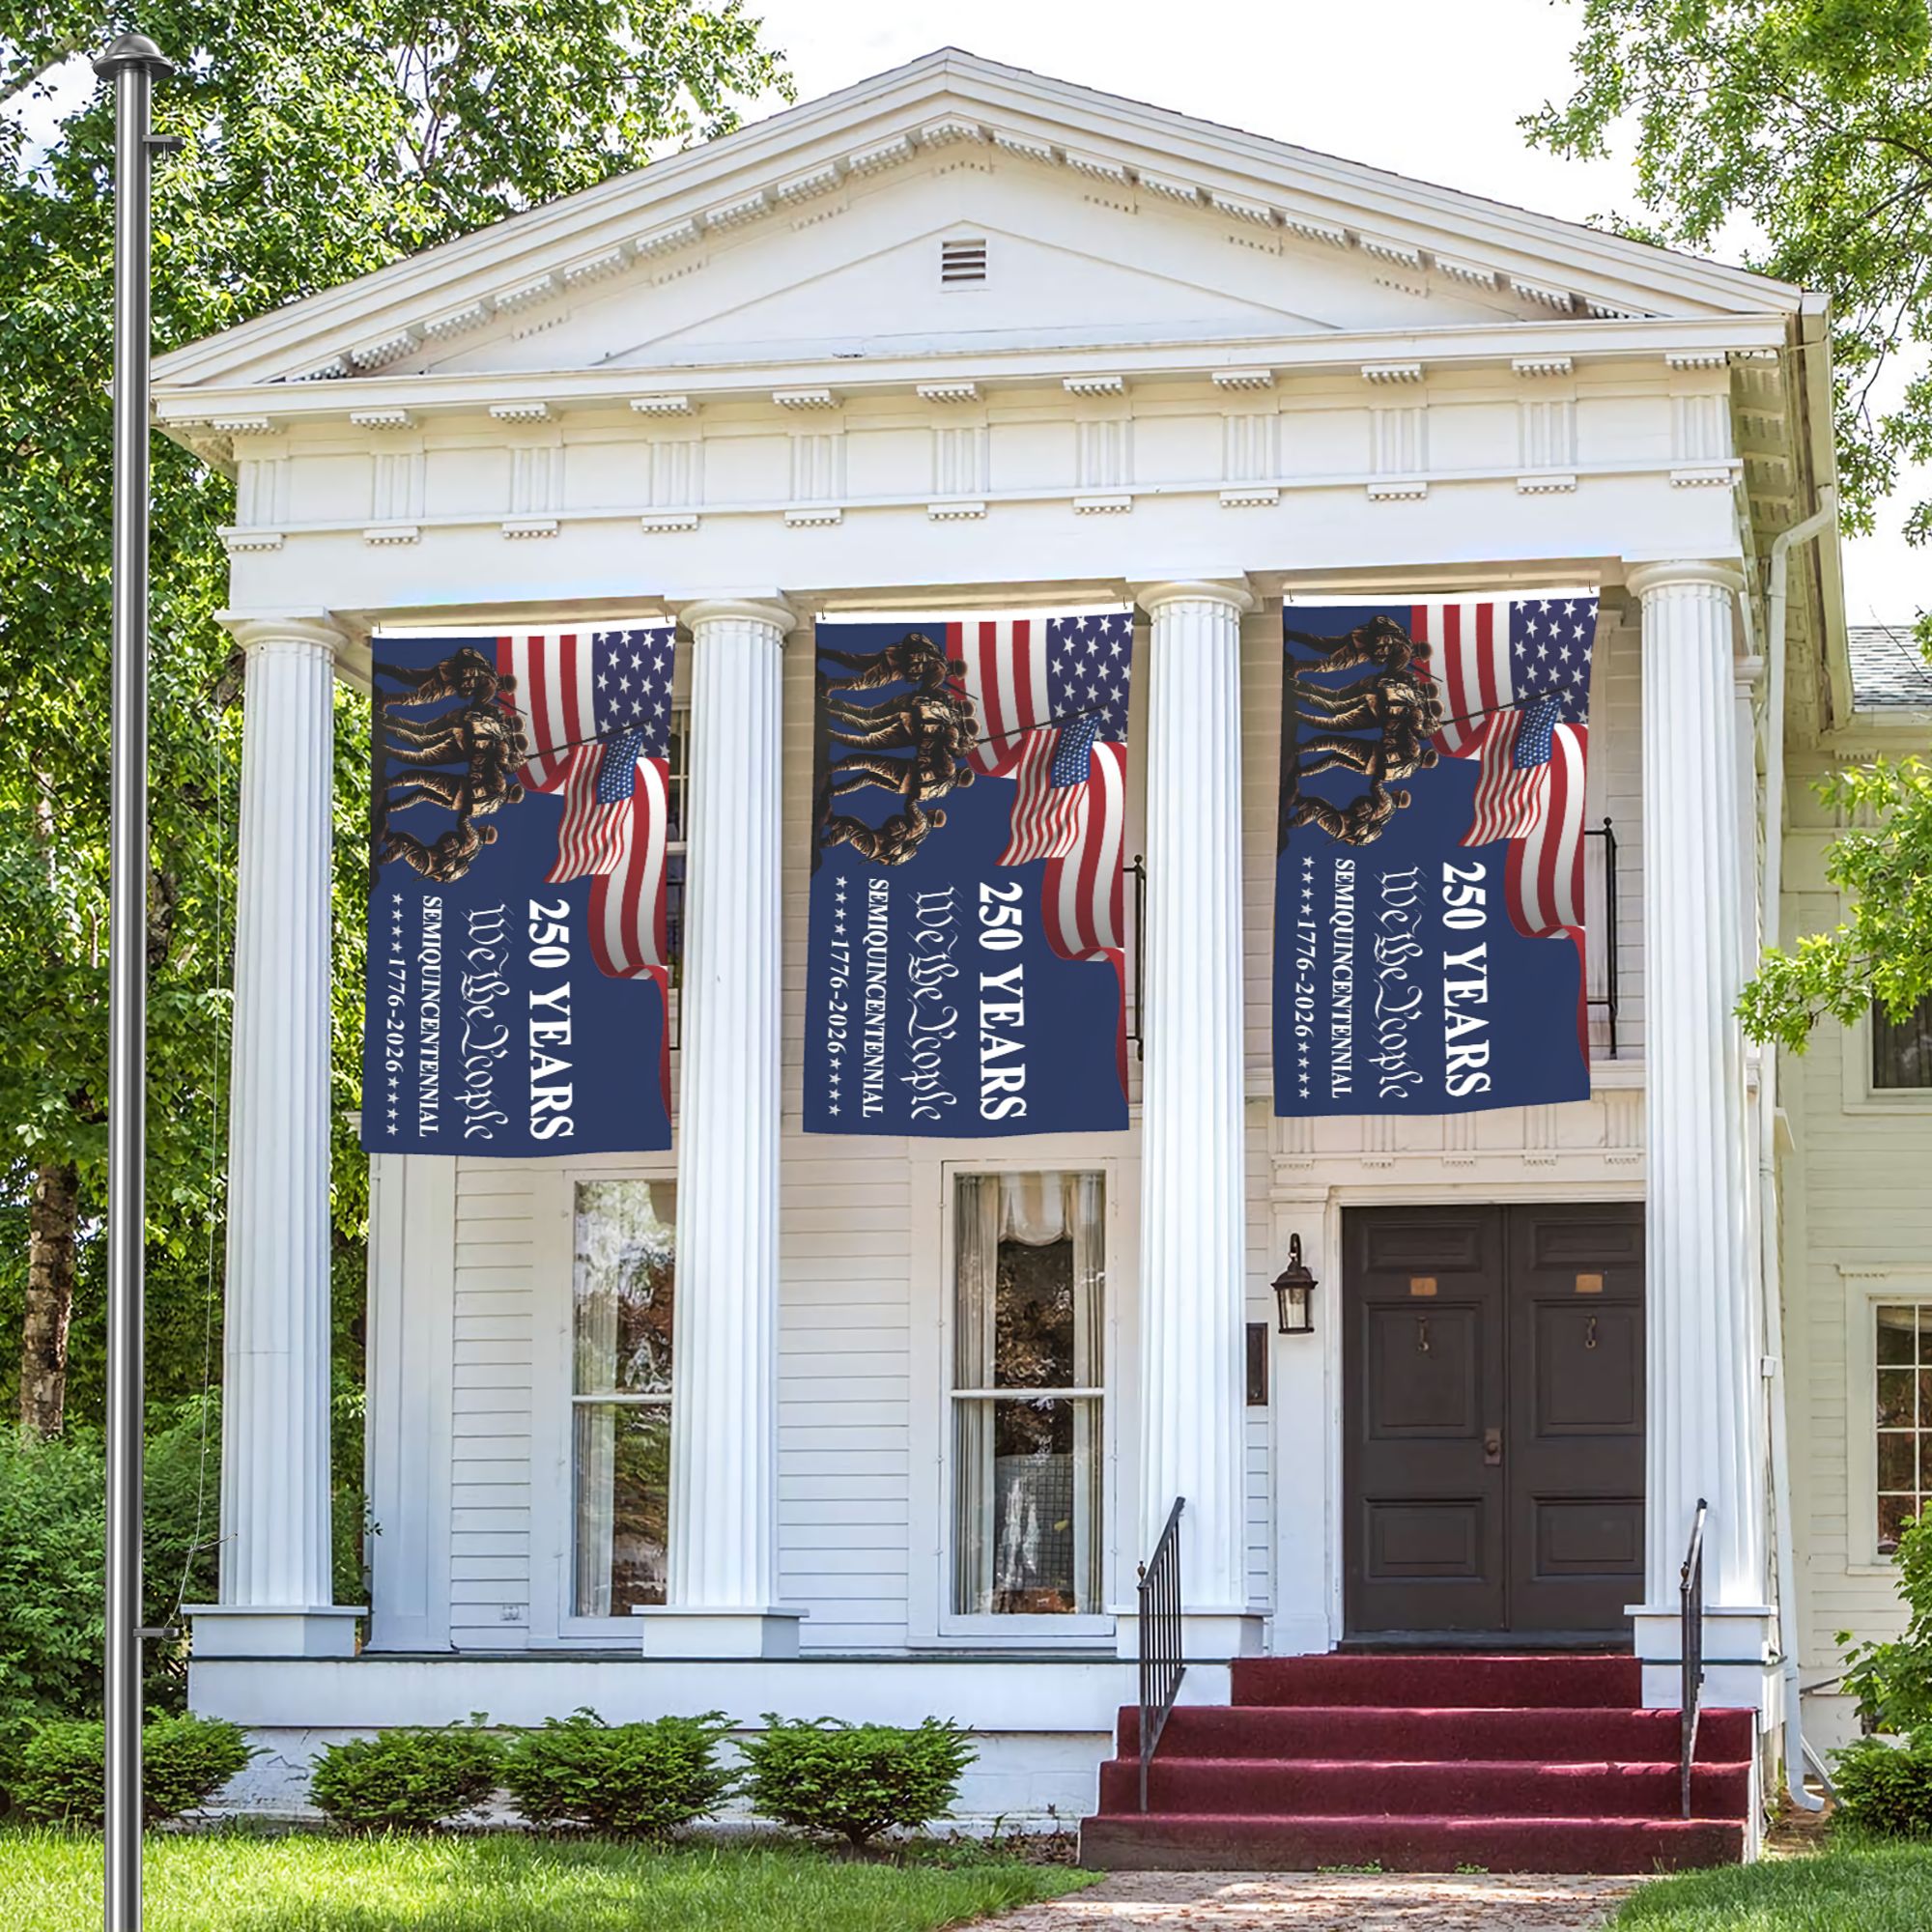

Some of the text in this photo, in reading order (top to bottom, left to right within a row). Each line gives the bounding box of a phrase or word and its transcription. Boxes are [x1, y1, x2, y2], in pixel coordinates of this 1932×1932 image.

[384, 958, 406, 1073] 1776-2026
[418, 895, 442, 1137] SEMIQUINCENTENNIAL
[448, 900, 514, 1140] We the People
[528, 898, 574, 1140] 250 YEARS
[827, 940, 849, 1054] 1776-2026
[862, 879, 890, 1118] SEMIQUINCENTENNIAL
[896, 882, 963, 1121] We the People
[979, 881, 1027, 1121] 250 YEARS
[1294, 919, 1316, 1038] 1776-2026
[1329, 859, 1355, 1098] SEMIQUINCENTENNIAL
[1363, 863, 1427, 1098] We the People
[1442, 862, 1491, 1097] 250 YEARS
